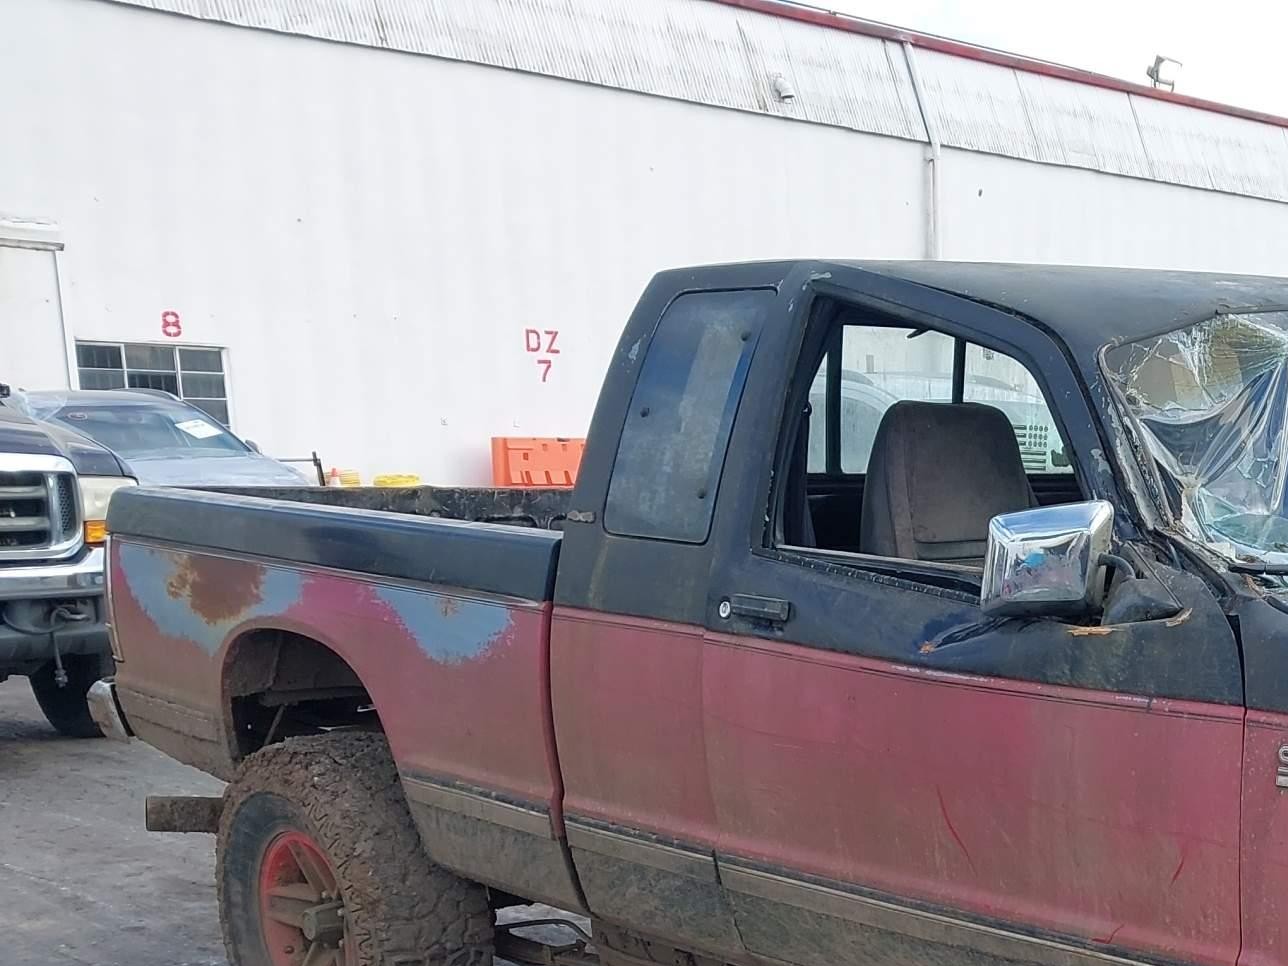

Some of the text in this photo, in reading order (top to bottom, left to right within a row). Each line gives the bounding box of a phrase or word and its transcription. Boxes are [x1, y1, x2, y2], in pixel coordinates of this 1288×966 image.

[161, 310, 182, 337] 8
[524, 328, 560, 354] DZ
[537, 359, 552, 383] 7
